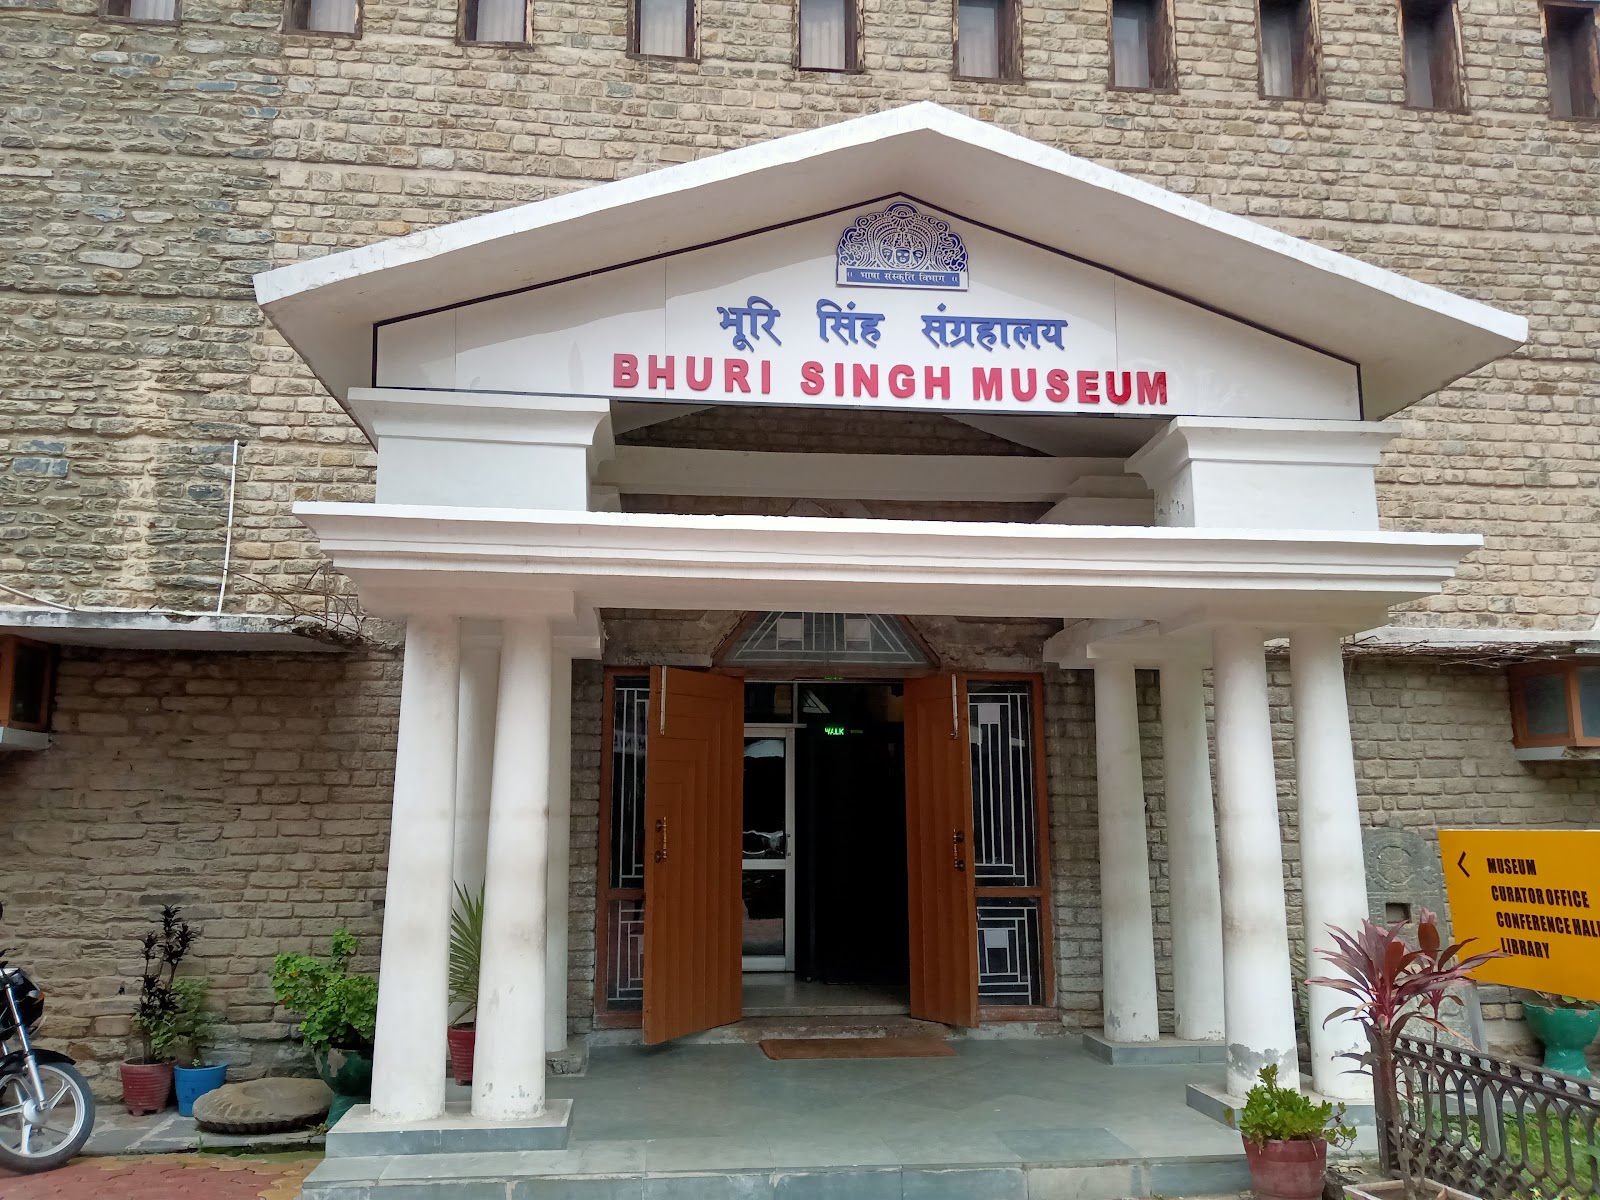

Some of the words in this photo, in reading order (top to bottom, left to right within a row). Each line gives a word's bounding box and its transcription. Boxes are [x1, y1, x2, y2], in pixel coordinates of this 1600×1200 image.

[860, 271, 880, 281] भाषा
[884, 271, 915, 284] संस्कृति
[919, 272, 945, 283] विभाग
[717, 296, 782, 352] भूरि
[816, 299, 886, 348] सिंह
[921, 303, 1068, 352] संग्रहालय
[612, 353, 771, 394] BHURI
[800, 360, 951, 399] SINGH
[972, 367, 1168, 405] MUSEUM
[1486, 857, 1537, 876] MUSEUM
[1491, 885, 1545, 905] CURATOR
[1545, 889, 1590, 909] OFFICE
[1495, 911, 1572, 935] CONFERENCE
[1500, 937, 1550, 959] LIBRARY
